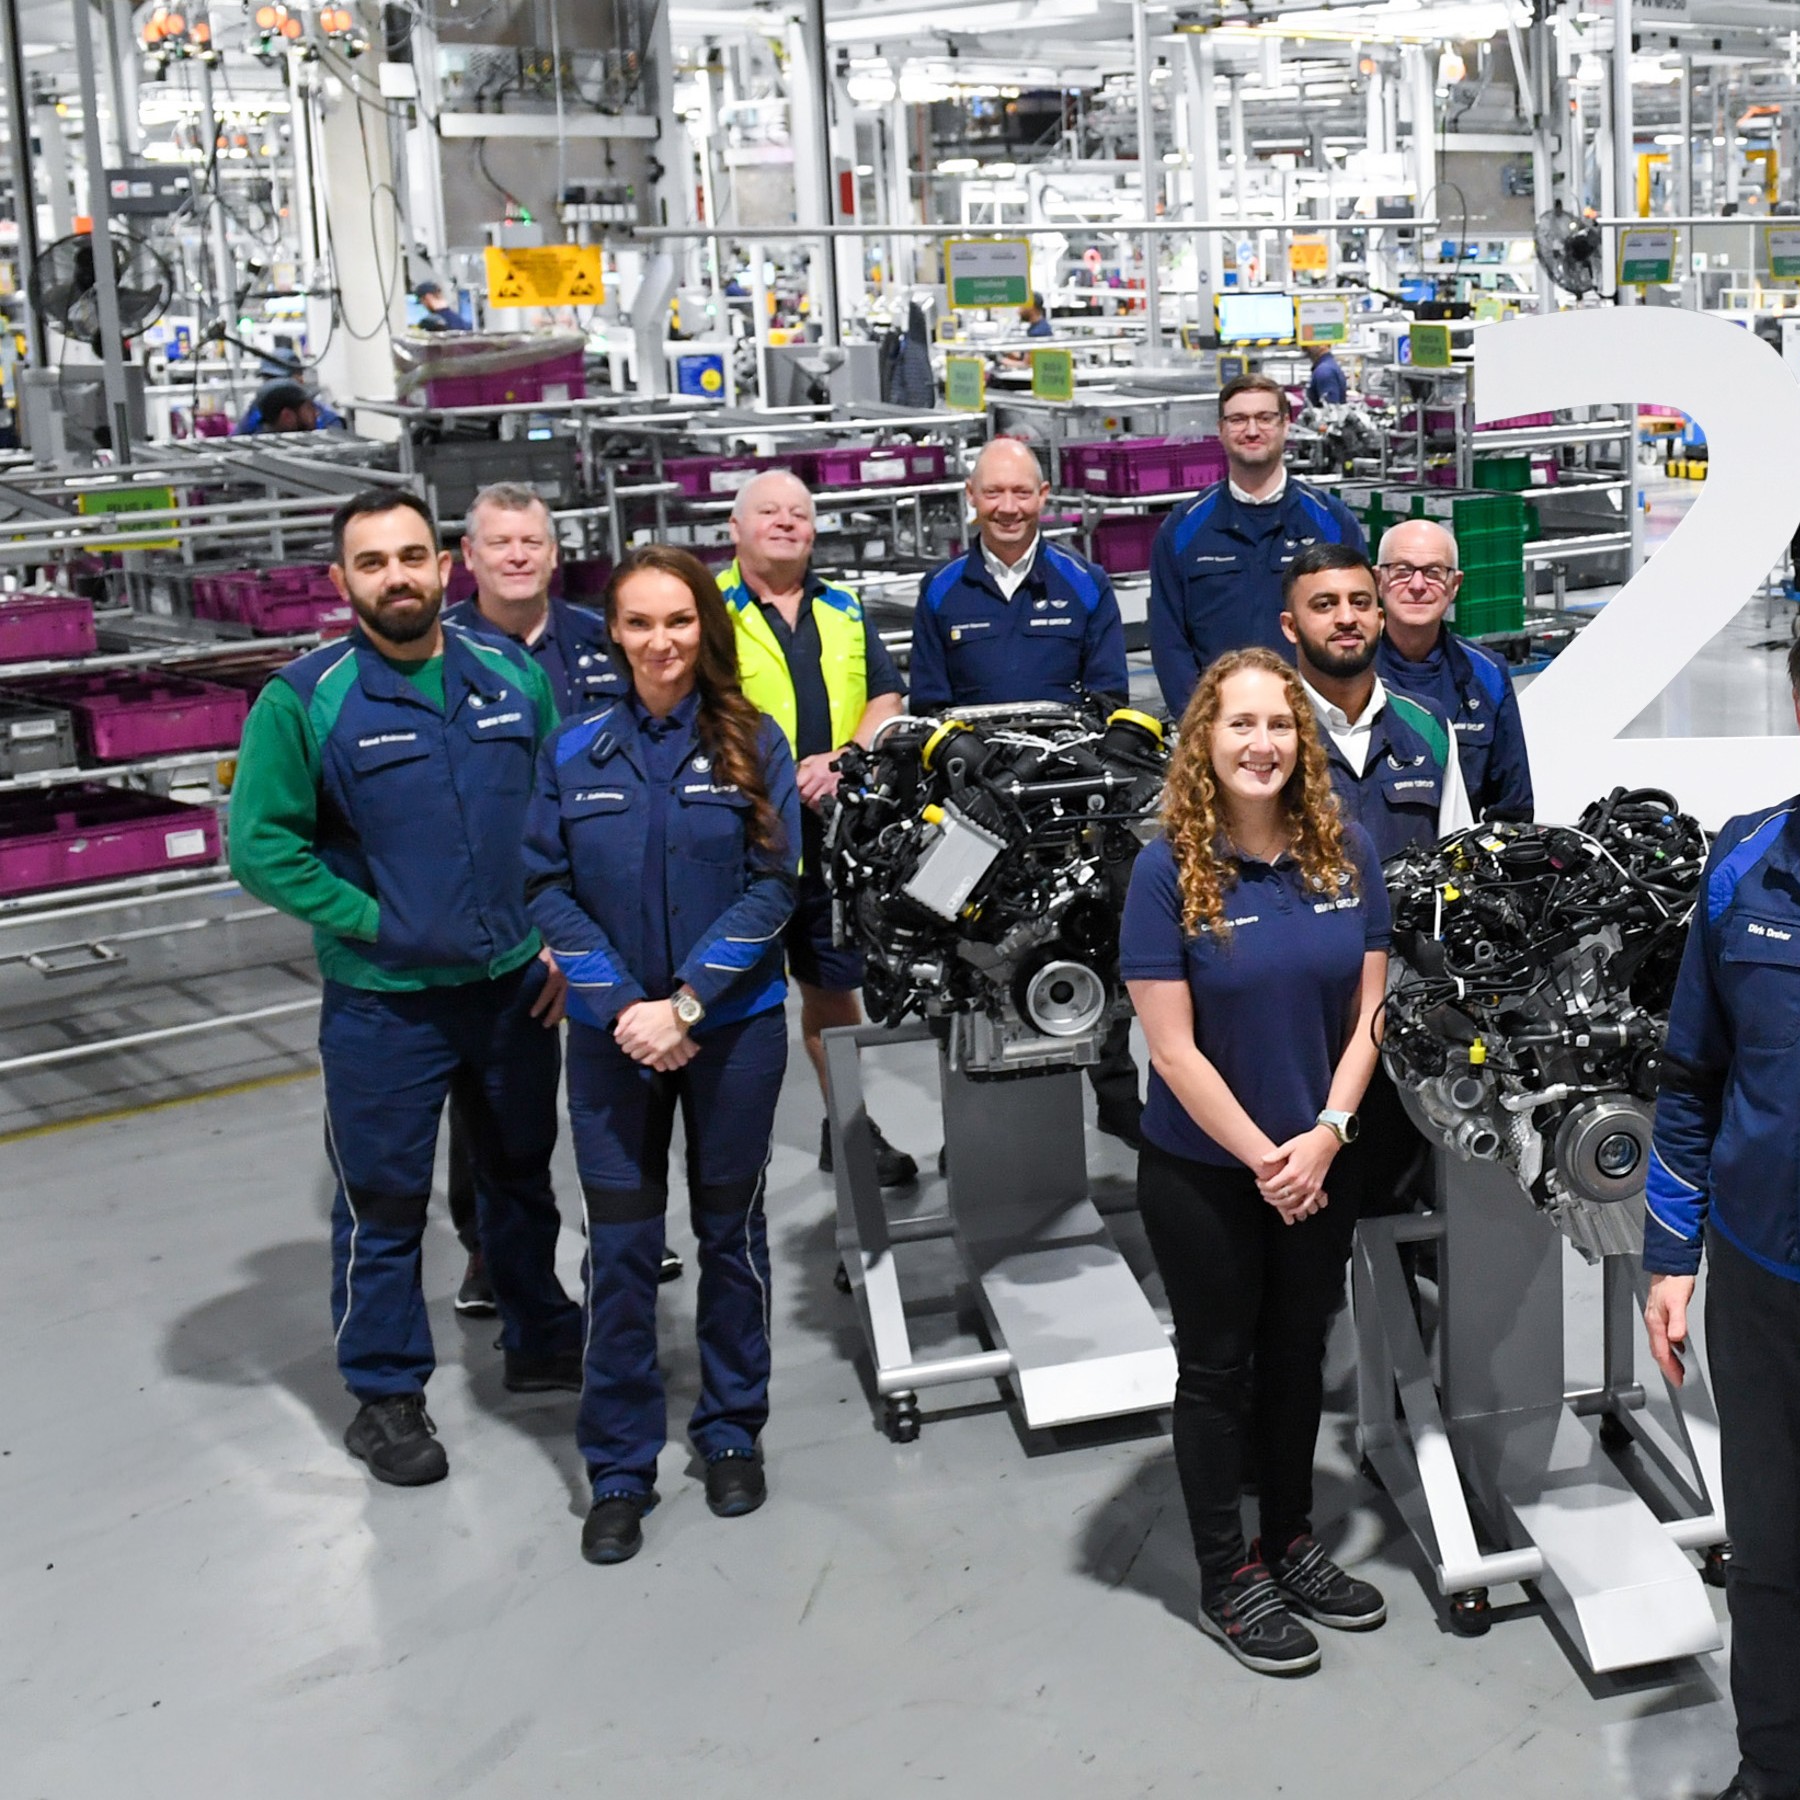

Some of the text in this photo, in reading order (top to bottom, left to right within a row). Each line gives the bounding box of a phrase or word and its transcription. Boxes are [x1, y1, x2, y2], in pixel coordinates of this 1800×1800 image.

[1313, 897, 1360, 914] BMW GROUP
[1747, 923, 1766, 936] Dirk
